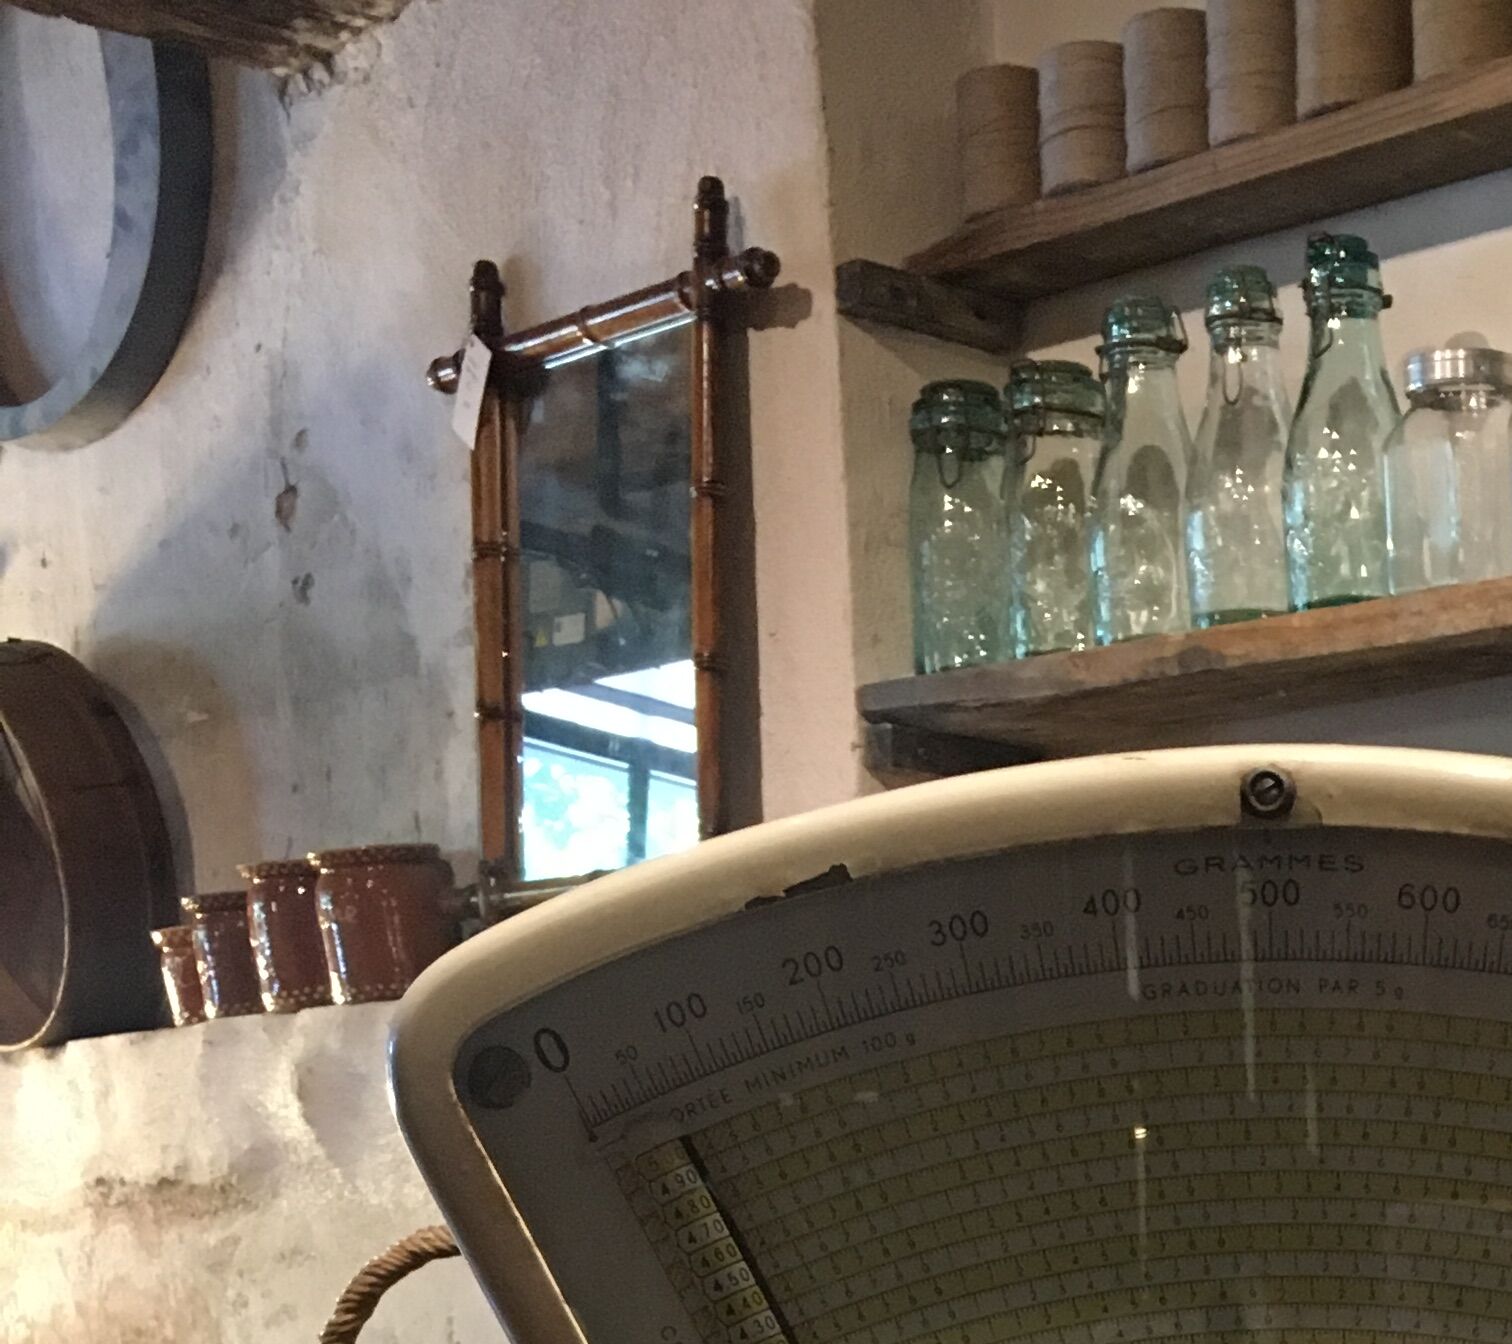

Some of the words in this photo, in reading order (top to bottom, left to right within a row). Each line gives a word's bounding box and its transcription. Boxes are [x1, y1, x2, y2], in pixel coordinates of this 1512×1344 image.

[1173, 852, 1365, 877] GRAMMES
[533, 1026, 570, 1074] 0
[614, 1044, 639, 1066] 50
[654, 992, 708, 1033] 100
[737, 992, 766, 1015] 150
[781, 945, 844, 986] 200
[871, 950, 908, 972] 250
[929, 909, 990, 947] 300
[1020, 920, 1055, 941] 350
[1082, 887, 1142, 918] 400
[1174, 904, 1210, 922] 450
[1242, 878, 1301, 908] 500
[1333, 901, 1370, 920] 550
[1398, 883, 1462, 914] 600
[1318, 977, 1359, 995] PAR
[1375, 978, 1386, 997] 5
[743, 1045, 850, 1095] MINIMUM
[862, 1031, 897, 1054] 100
